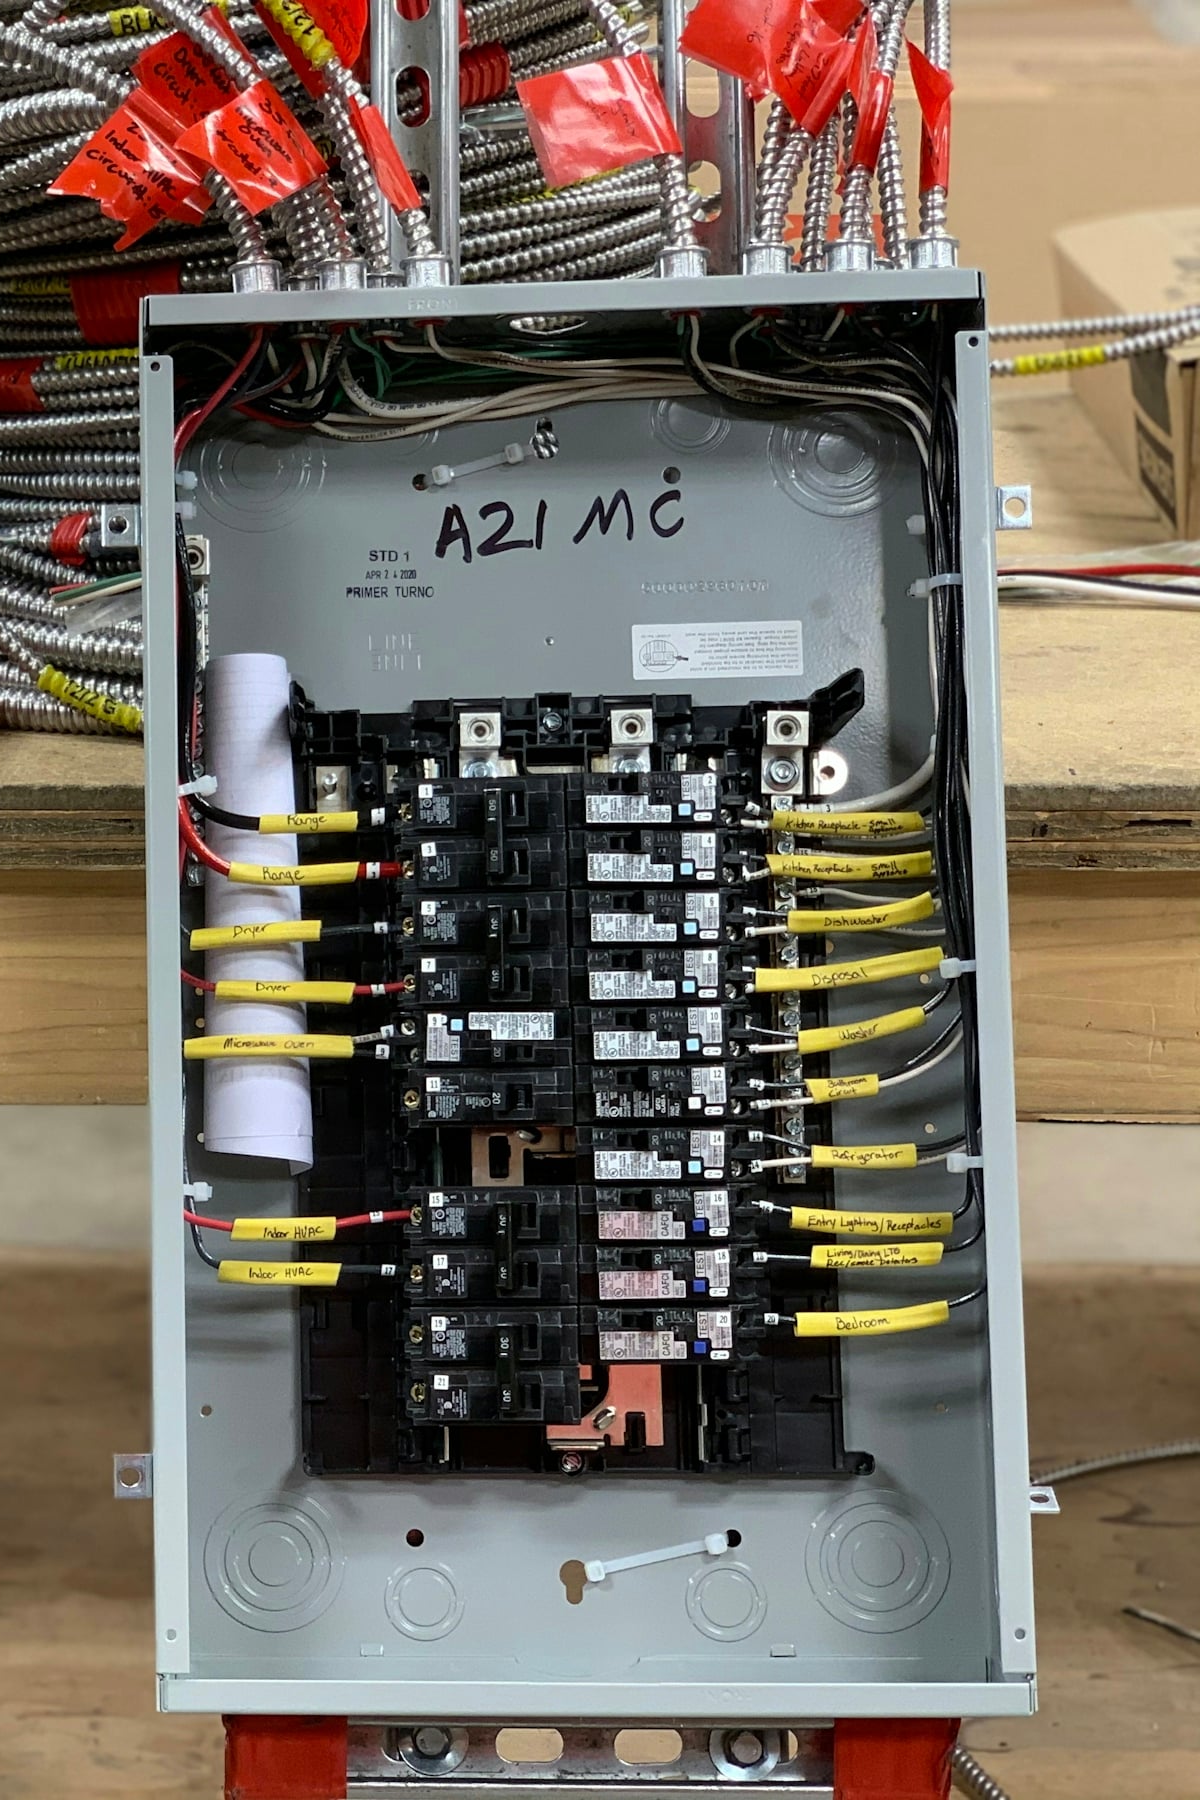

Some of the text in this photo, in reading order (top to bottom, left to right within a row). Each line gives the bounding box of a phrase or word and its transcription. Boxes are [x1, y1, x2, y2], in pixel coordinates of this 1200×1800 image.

[435, 499, 547, 563] A21
[369, 550, 410, 562] STD 1
[365, 570, 382, 580] APR
[346, 586, 435, 598] PRIMER TURNO
[103, 698, 117, 714] G
[683, 775, 692, 800] TEST
[287, 814, 327, 831] Range
[683, 833, 692, 859] TEST
[263, 866, 305, 882] Range
[687, 893, 696, 917] TEST
[232, 923, 268, 939] Dryer
[686, 951, 695, 975] TEST
[811, 967, 868, 988] Disposal
[256, 981, 292, 993] Dryer
[689, 1008, 698, 1031] TEST
[838, 1023, 879, 1041] Washer
[450, 1037, 459, 1061] TEST
[693, 1069, 702, 1092] TEST
[492, 1092, 501, 1105] 20
[692, 1131, 700, 1155] TEST
[831, 1149, 904, 1166] Refrigerator
[655, 1193, 663, 1205] 20
[695, 1193, 704, 1218] TEST
[661, 1213, 669, 1237] CAFCI
[807, 1214, 837, 1230] Entry
[263, 1225, 324, 1240] Indoor HVAC
[654, 1254, 662, 1265] 20
[696, 1251, 705, 1277] TEST
[248, 1265, 315, 1279] Indoor HVAC
[662, 1272, 670, 1296] CAFCI
[656, 1315, 664, 1327] 20
[698, 1313, 707, 1338] TEST
[767, 1314, 776, 1324] 20
[836, 1315, 890, 1332] Bedroom
[500, 1337, 509, 1350] 30
[502, 1389, 512, 1403] 30
